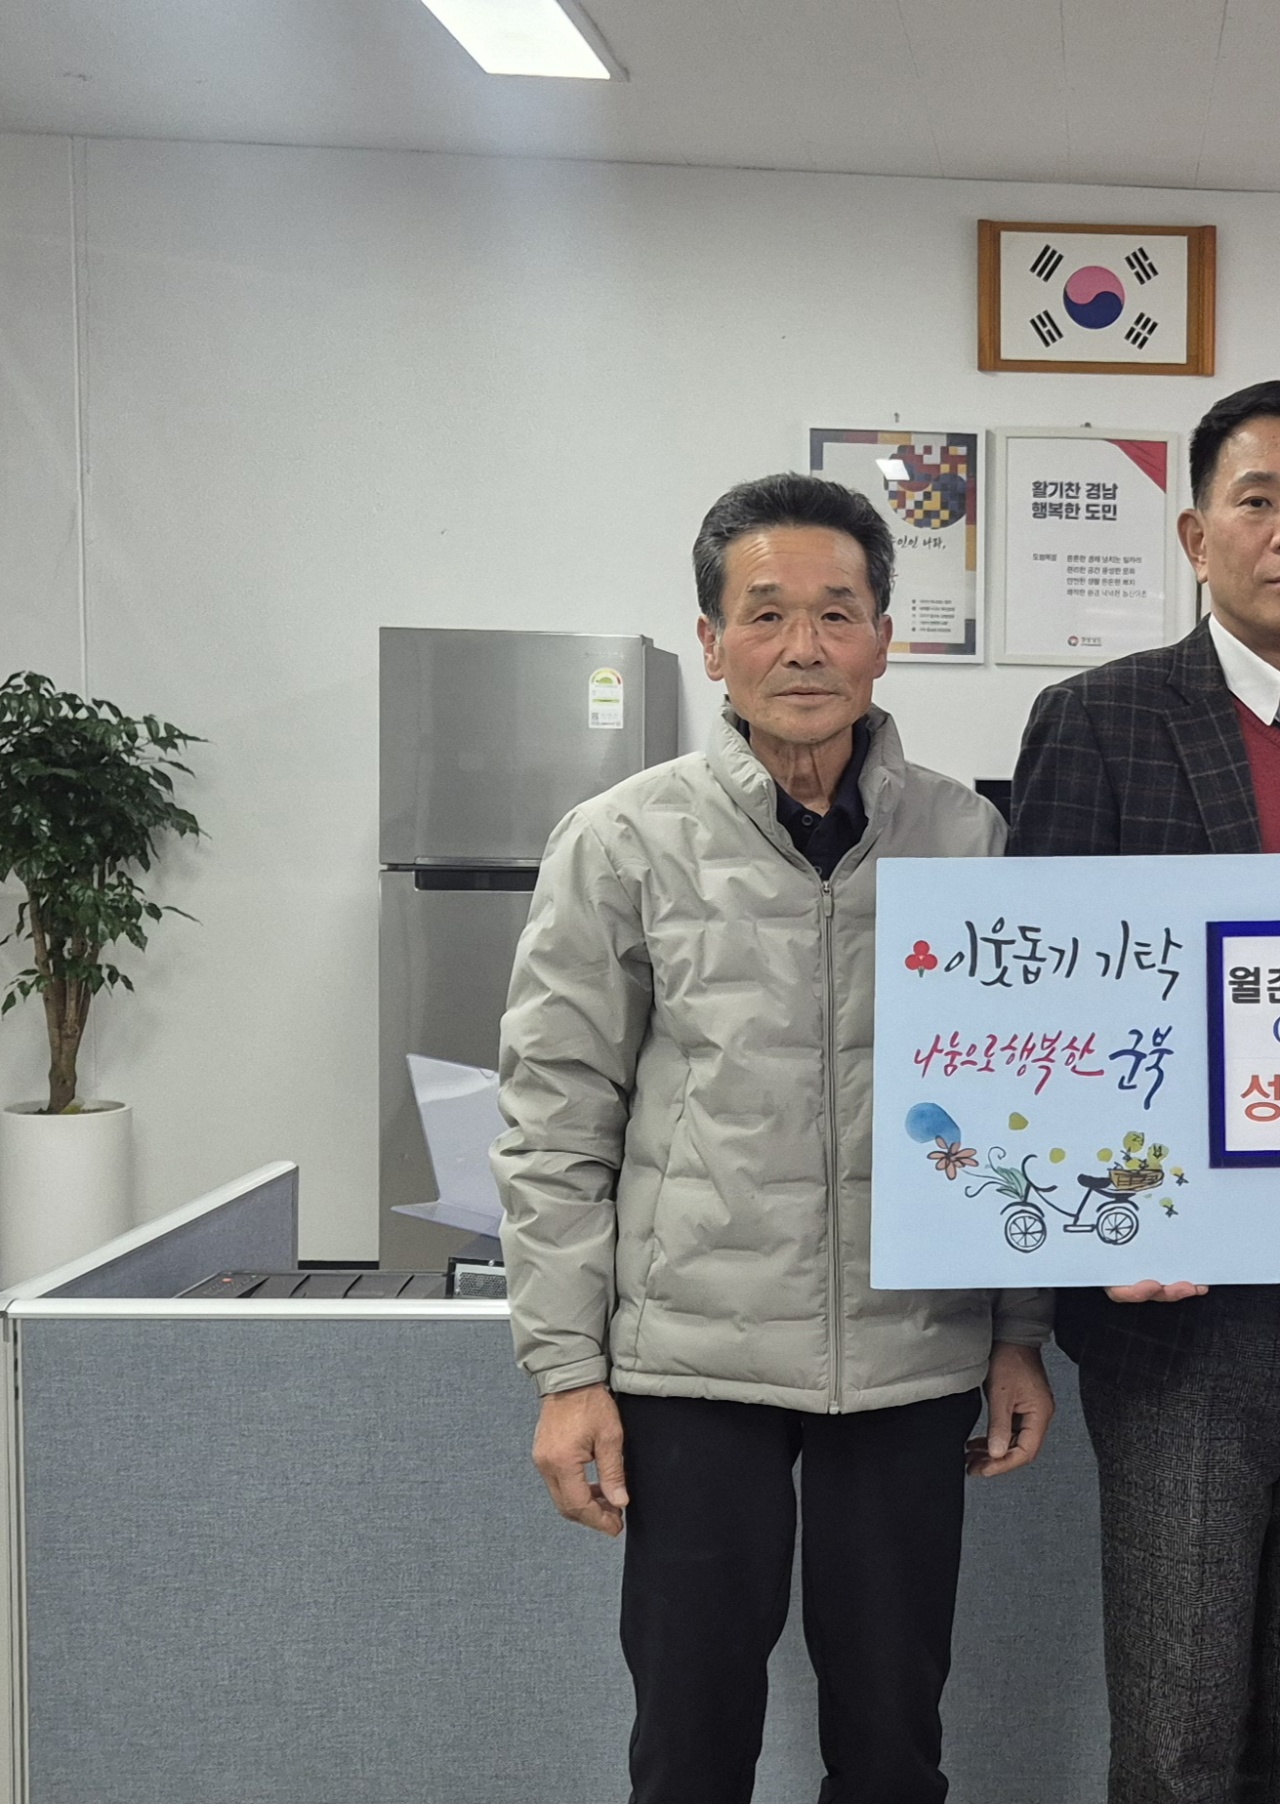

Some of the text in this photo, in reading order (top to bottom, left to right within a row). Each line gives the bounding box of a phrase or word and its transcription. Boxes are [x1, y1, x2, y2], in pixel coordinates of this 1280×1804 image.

[1032, 481, 1118, 500] 활기찬 경남
[1032, 502, 1117, 521] 행복한 도민
[944, 917, 1183, 1001] 이웃돕기 기탁
[1108, 1025, 1175, 1110] 군북
